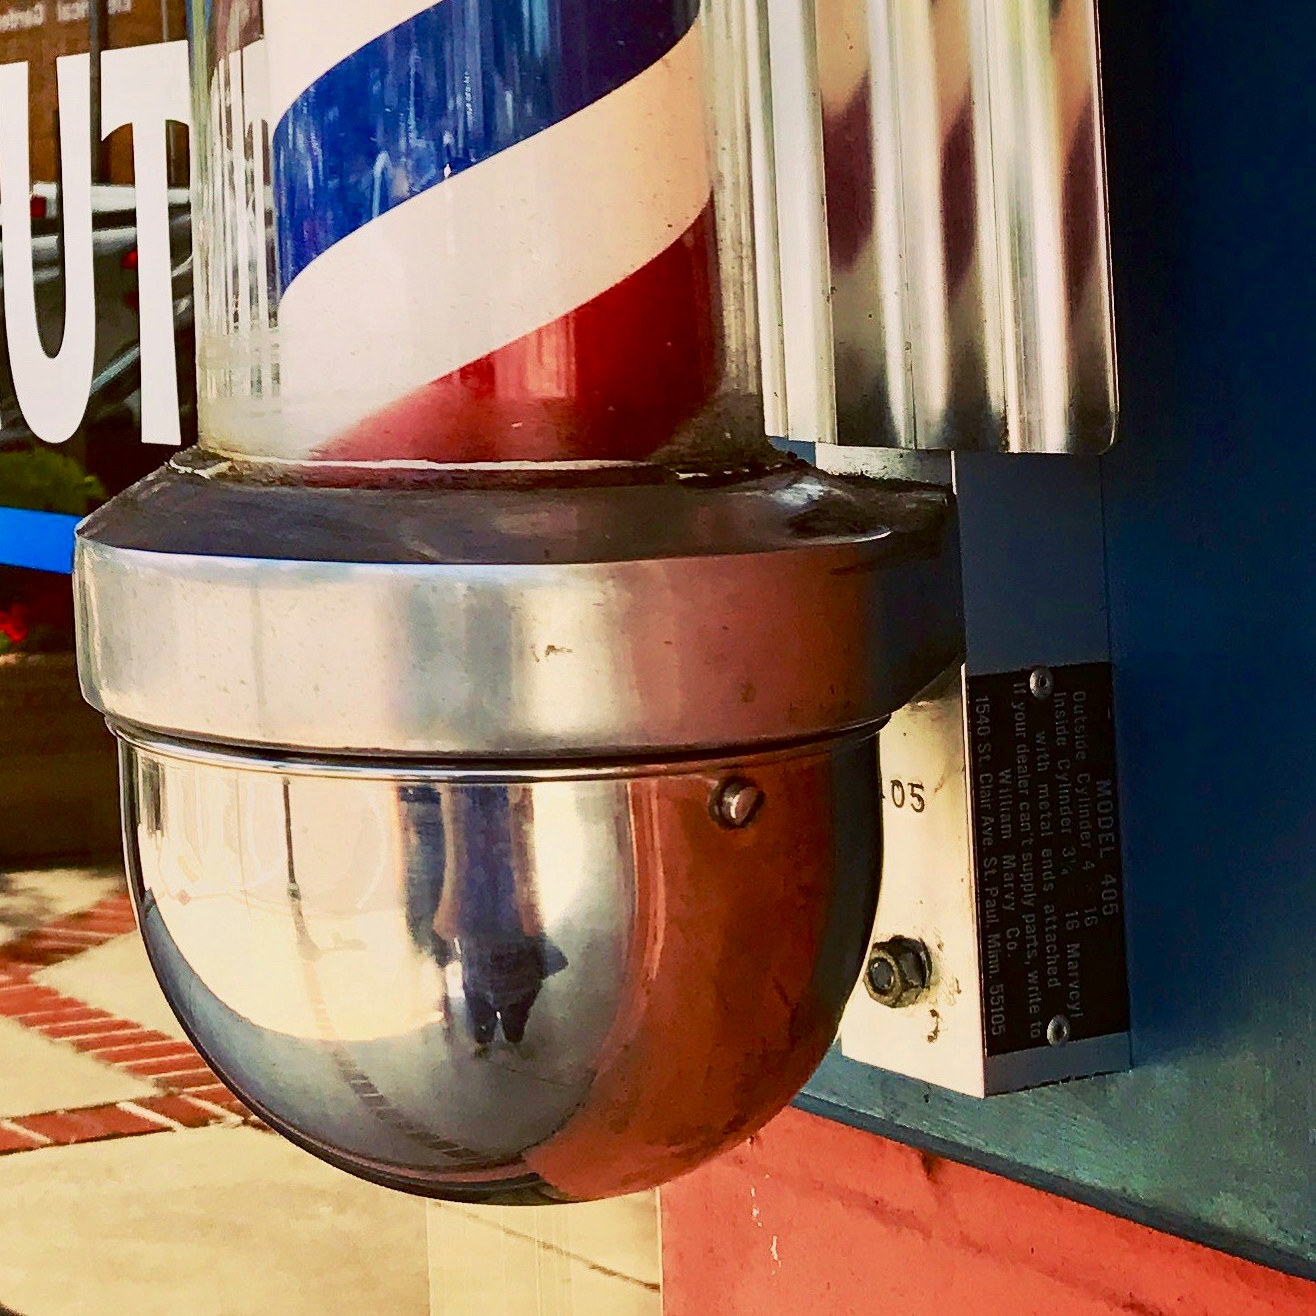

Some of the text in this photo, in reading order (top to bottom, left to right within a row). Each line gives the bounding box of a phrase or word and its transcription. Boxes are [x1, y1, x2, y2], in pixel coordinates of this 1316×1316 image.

[975, 695, 992, 737] 1540
[1053, 691, 1070, 746] Inside
[1072, 691, 1088, 761] Outside
[881, 779, 925, 813] 05
[978, 773, 995, 809] Clair
[1055, 759, 1073, 834] Cylinder
[1074, 773, 1094, 849] Cylinder
[980, 815, 996, 851] Ave.
[1011, 682, 1044, 1039] If your dealer can't supply parts, write to
[1035, 731, 1061, 988] with metal ends attached
[1095, 779, 1119, 916] MODEL 405
[982, 856, 999, 882] St.
[998, 768, 1021, 957] William Marvy Co.
[986, 933, 1002, 979] Minn.
[988, 984, 1006, 1036] 55105
